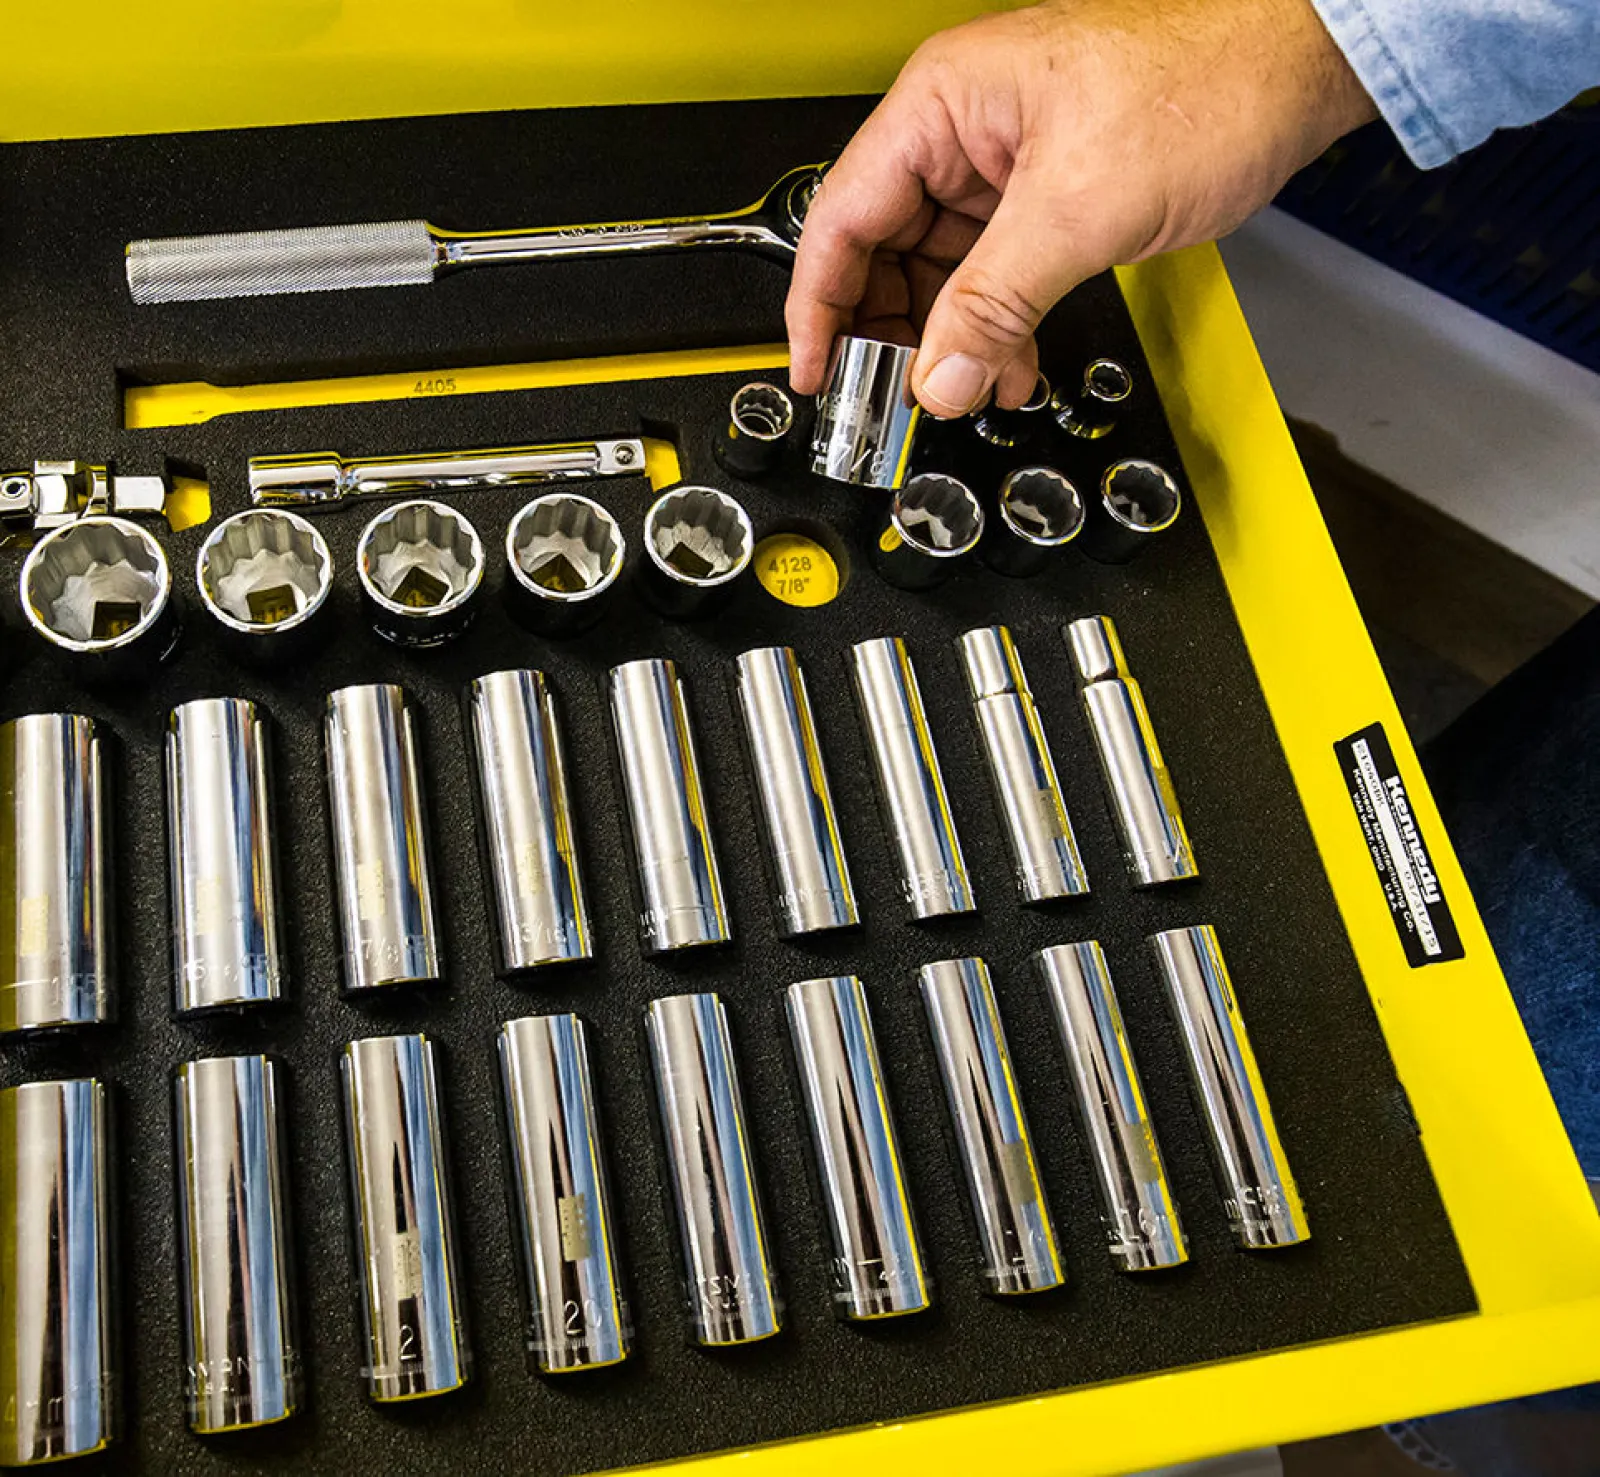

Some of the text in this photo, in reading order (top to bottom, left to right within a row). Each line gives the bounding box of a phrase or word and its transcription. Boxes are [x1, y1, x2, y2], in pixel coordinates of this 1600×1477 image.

[414, 378, 456, 394] 4405
[768, 556, 811, 574] 4128
[776, 577, 810, 595] 7/8"
[1353, 768, 1376, 820] Kennedy
[1372, 822, 1408, 909] Manufacturing
[1385, 775, 1441, 904] Kennedy
